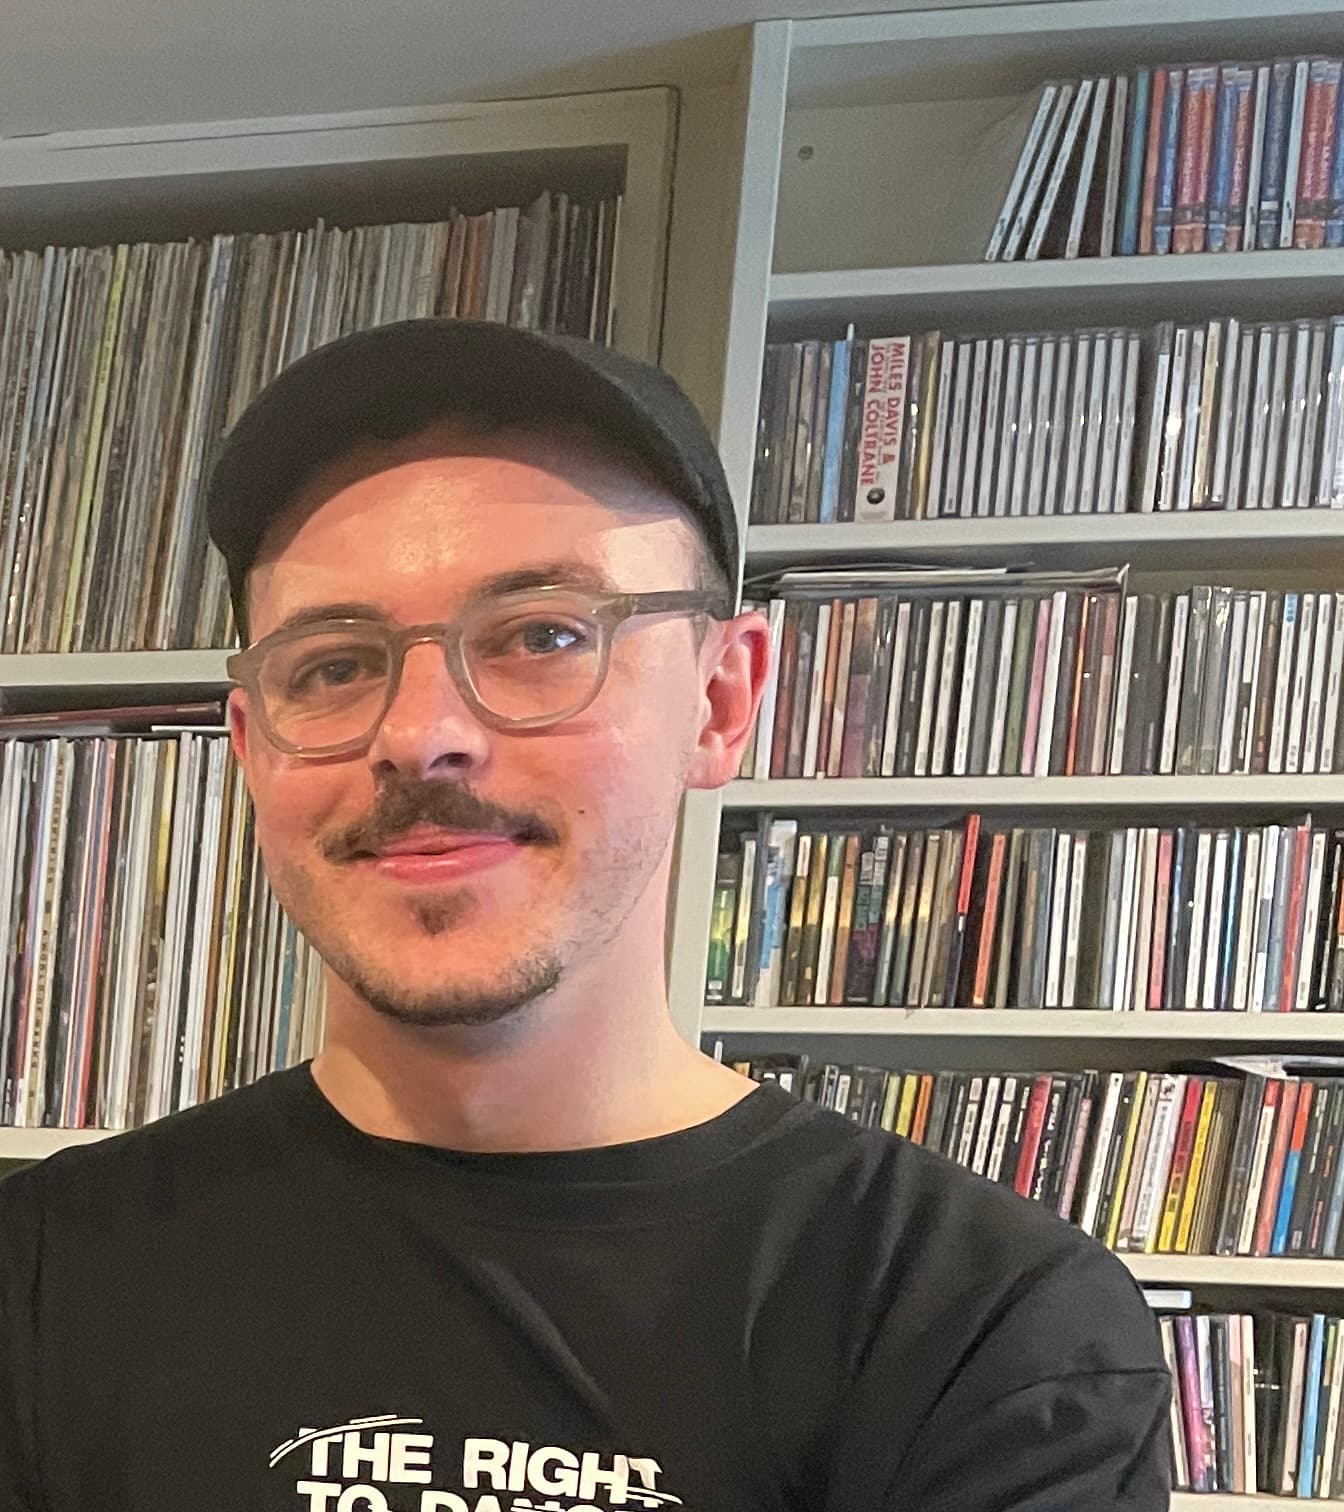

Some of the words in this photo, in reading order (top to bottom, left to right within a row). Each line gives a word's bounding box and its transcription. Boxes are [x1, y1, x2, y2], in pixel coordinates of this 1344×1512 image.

[869, 344, 885, 393] JOHN
[889, 342, 906, 391] MILES
[860, 399, 880, 486] COLTRANE
[884, 397, 901, 446] DAVIS
[297, 1427, 434, 1484] THE
[462, 1437, 664, 1508] RIGHT
